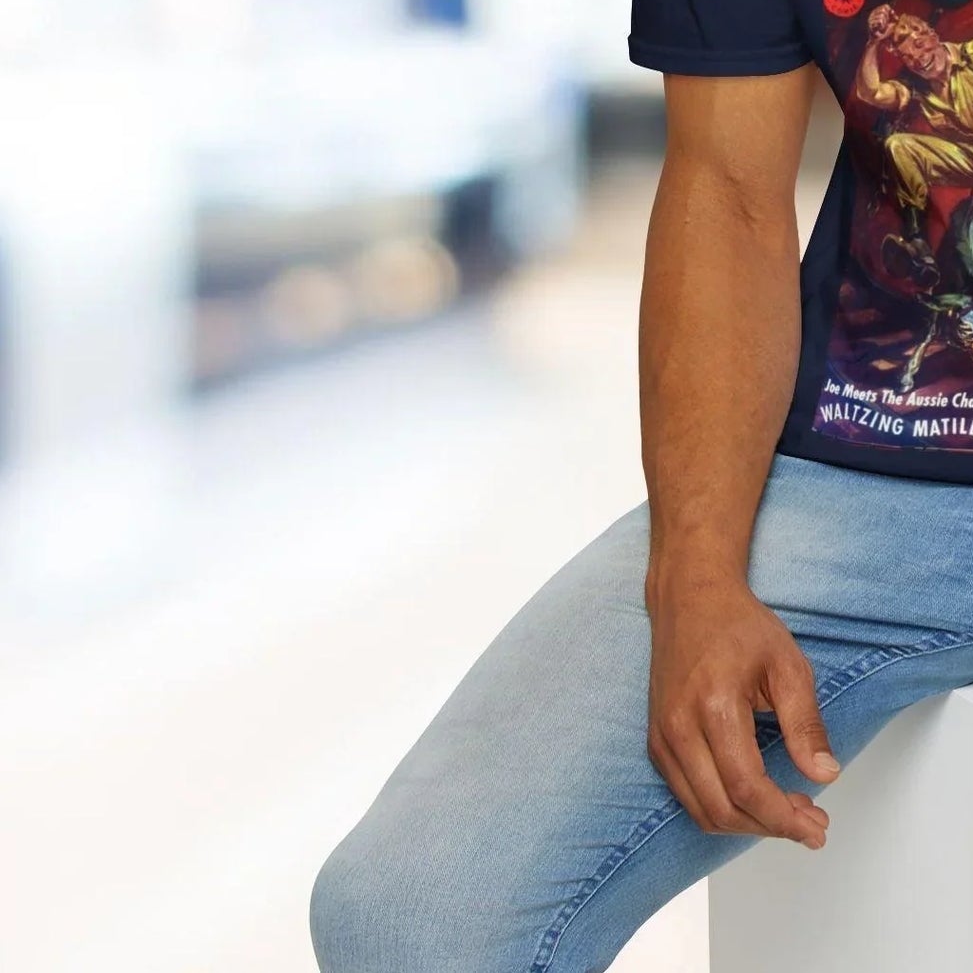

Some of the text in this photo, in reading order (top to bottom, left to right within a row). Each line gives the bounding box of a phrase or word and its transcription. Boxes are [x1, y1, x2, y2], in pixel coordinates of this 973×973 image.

[824, 378, 841, 395] Joe
[842, 384, 878, 404] Meets
[882, 389, 903, 406] The
[906, 392, 949, 408] Aussie
[820, 402, 904, 436] WALTZING
